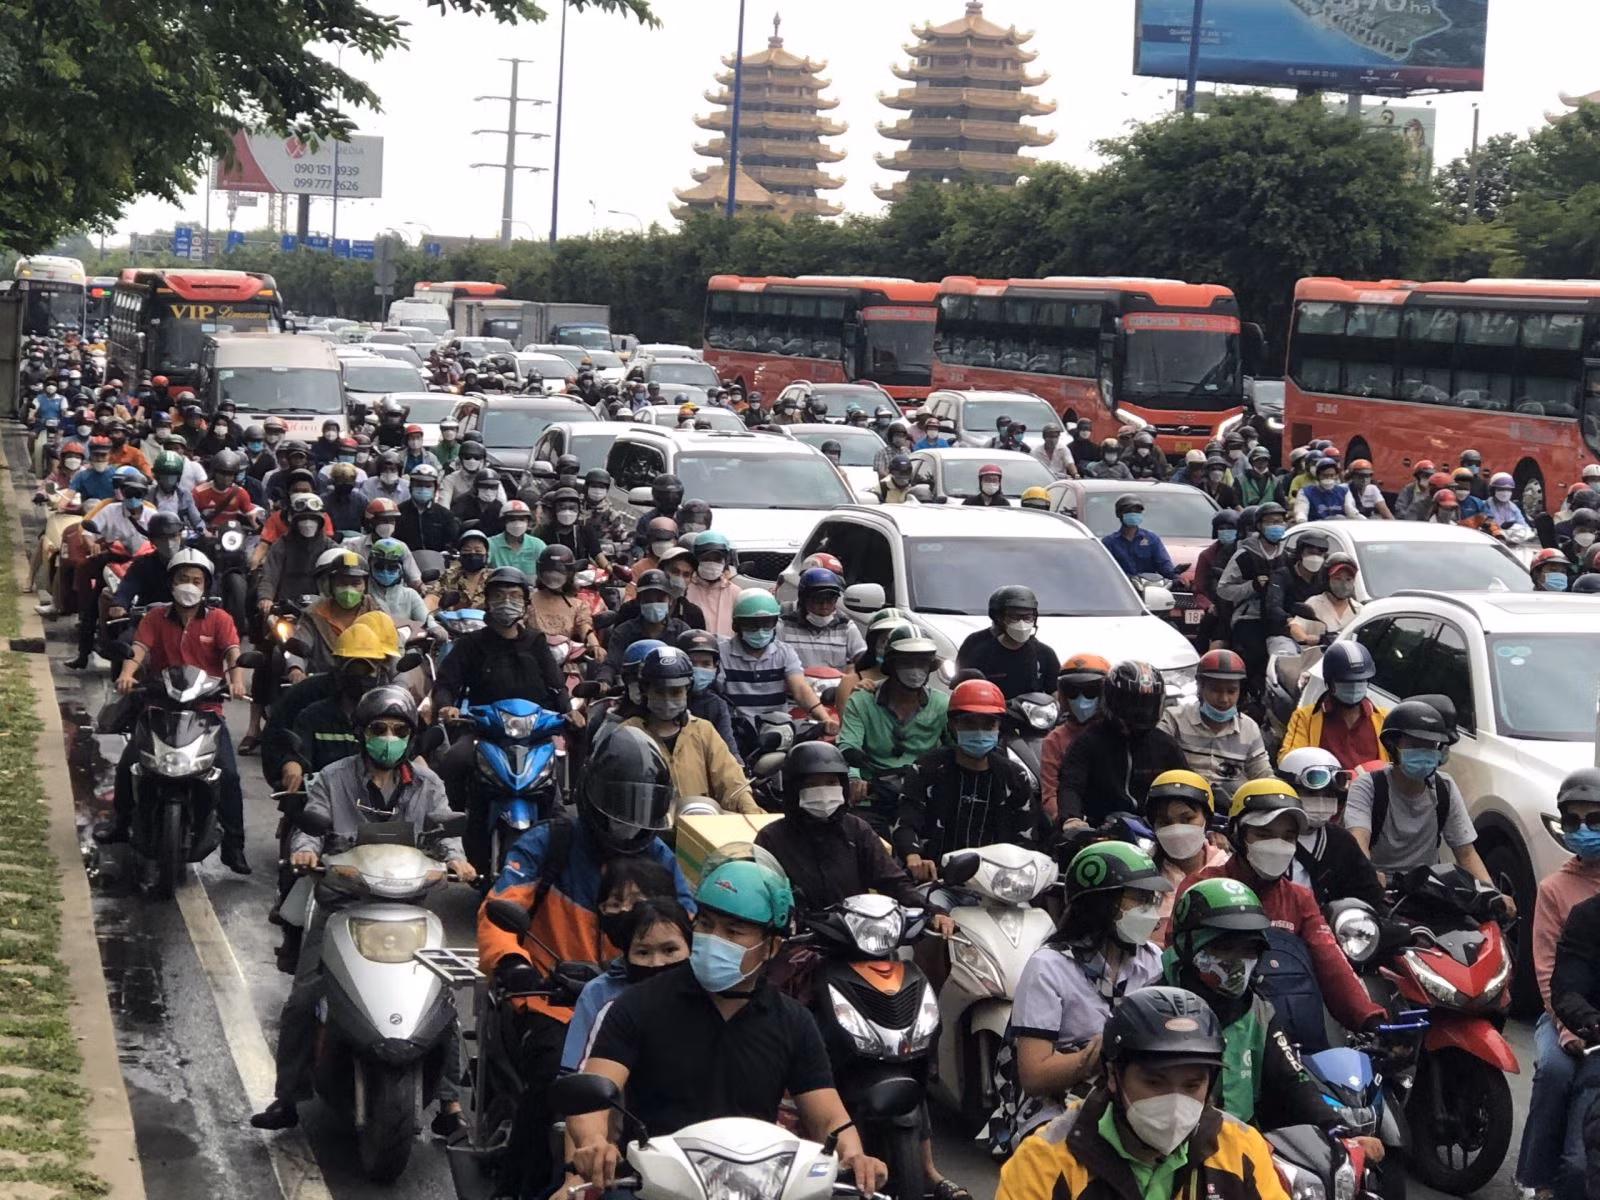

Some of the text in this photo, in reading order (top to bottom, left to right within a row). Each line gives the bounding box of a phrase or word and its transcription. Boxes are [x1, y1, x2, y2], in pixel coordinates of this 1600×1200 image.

[294, 163, 314, 174] 090
[316, 165, 331, 175] 151
[293, 178, 313, 188] 099
[315, 179, 332, 189] 777
[170, 304, 214, 320] VIP
[1188, 612, 1199, 622] 18
